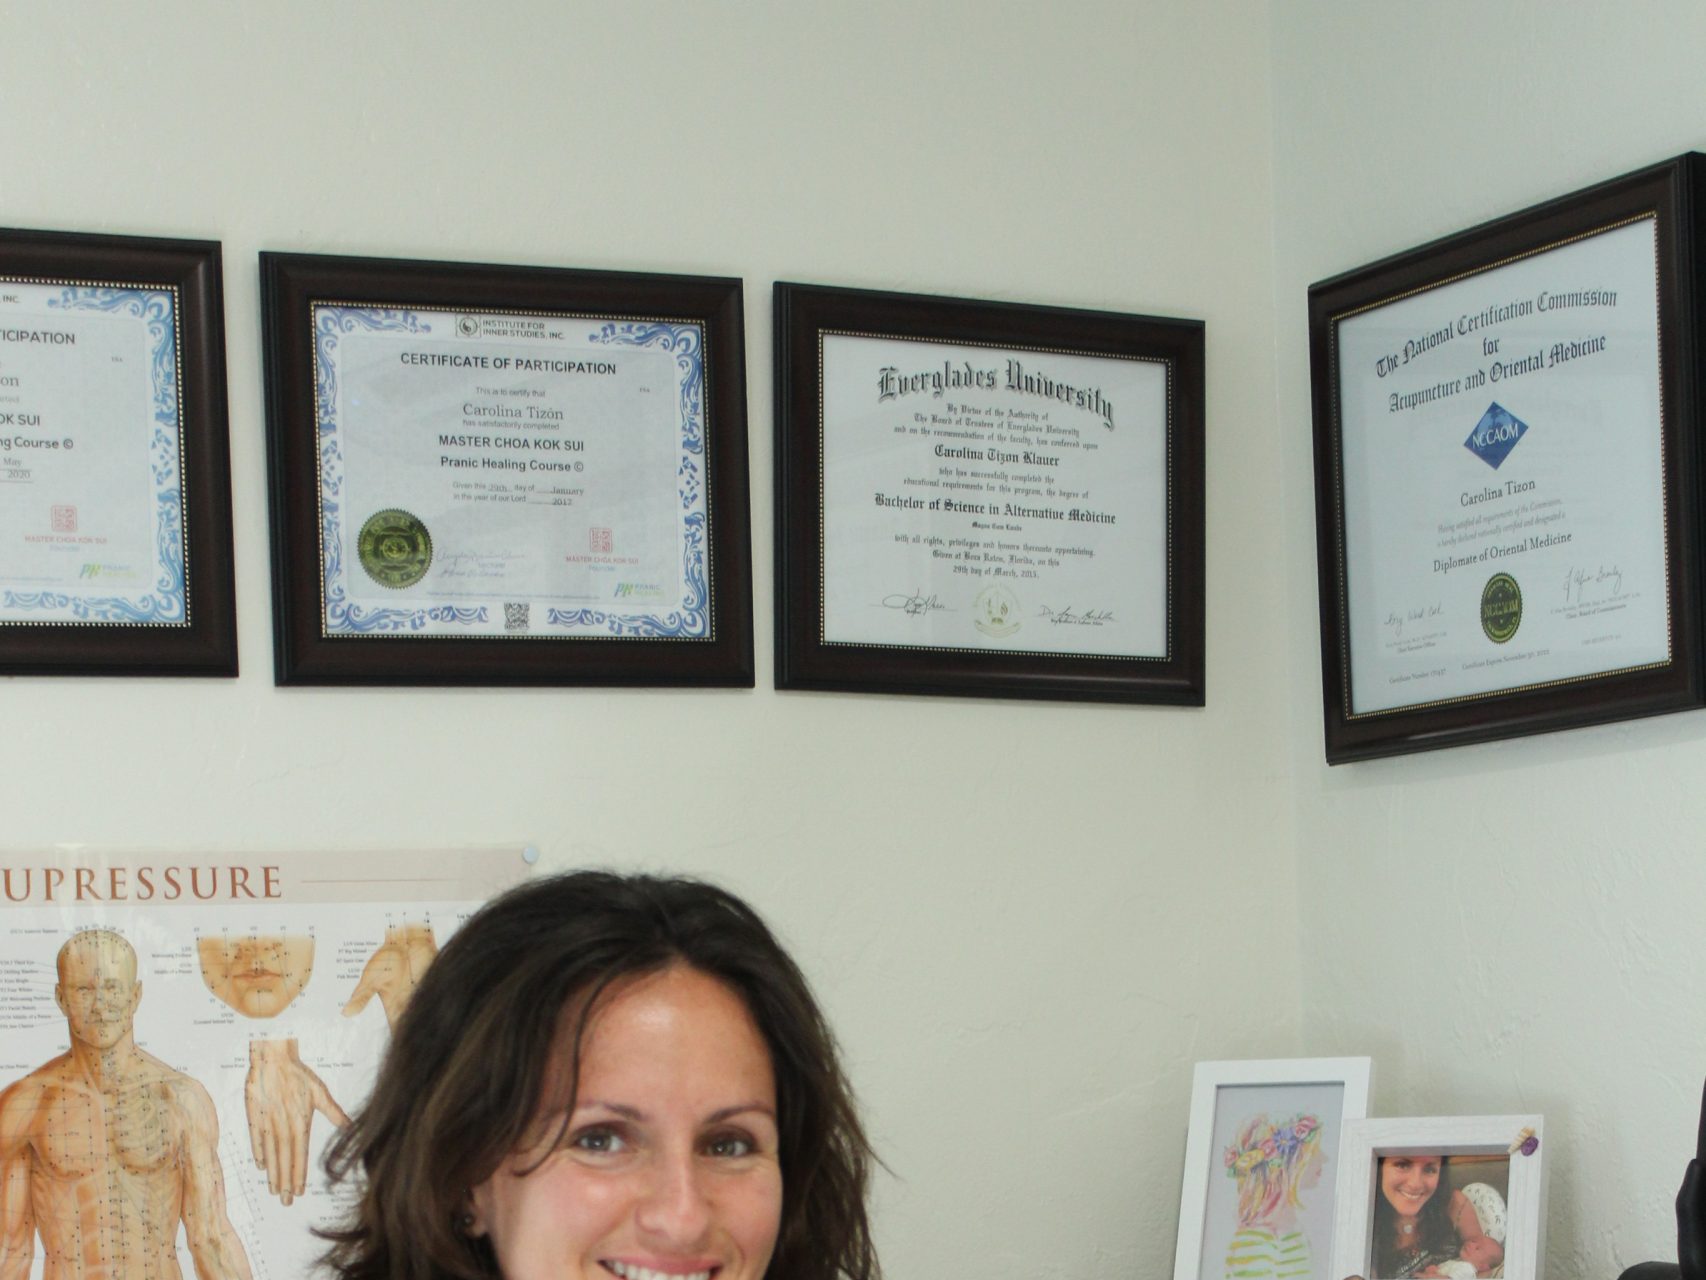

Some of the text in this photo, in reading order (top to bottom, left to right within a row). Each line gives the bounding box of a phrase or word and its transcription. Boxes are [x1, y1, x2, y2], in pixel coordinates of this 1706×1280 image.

[483, 319, 545, 331] INSTITUTE FOR
[483, 327, 508, 337] INNER
[1375, 287, 1618, 379] The National Certification Commission
[0, 330, 76, 345] ICIPATION
[1482, 336, 1500, 358] for
[401, 353, 616, 375] CERTIFICATE OF PARTICIPATION
[1389, 334, 1607, 414] Acupuncture and Oriental Medicine
[878, 359, 1114, 431] Everglades University
[18, 414, 40, 426] SUI
[463, 403, 522, 418] Carolina
[1007, 409, 1039, 422] Authority
[523, 423, 560, 431] completed
[1472, 422, 1519, 449] NCCAOM
[14, 437, 59, 449] Course
[439, 435, 584, 452] MASTER CHOA KOK SUI
[440, 456, 479, 468] Pranic
[482, 457, 527, 473] Healing
[529, 460, 571, 472] Course
[934, 443, 1061, 467] Carolina Tizon Klauer
[551, 486, 585, 496] January
[1460, 479, 1536, 507] Carolina Tizon
[875, 492, 1116, 525] Bachelor of Science in Alternative Medicine
[1433, 533, 1572, 574] Diplomate of Oriental Medicine
[0, 865, 282, 902] UPRESSURE
